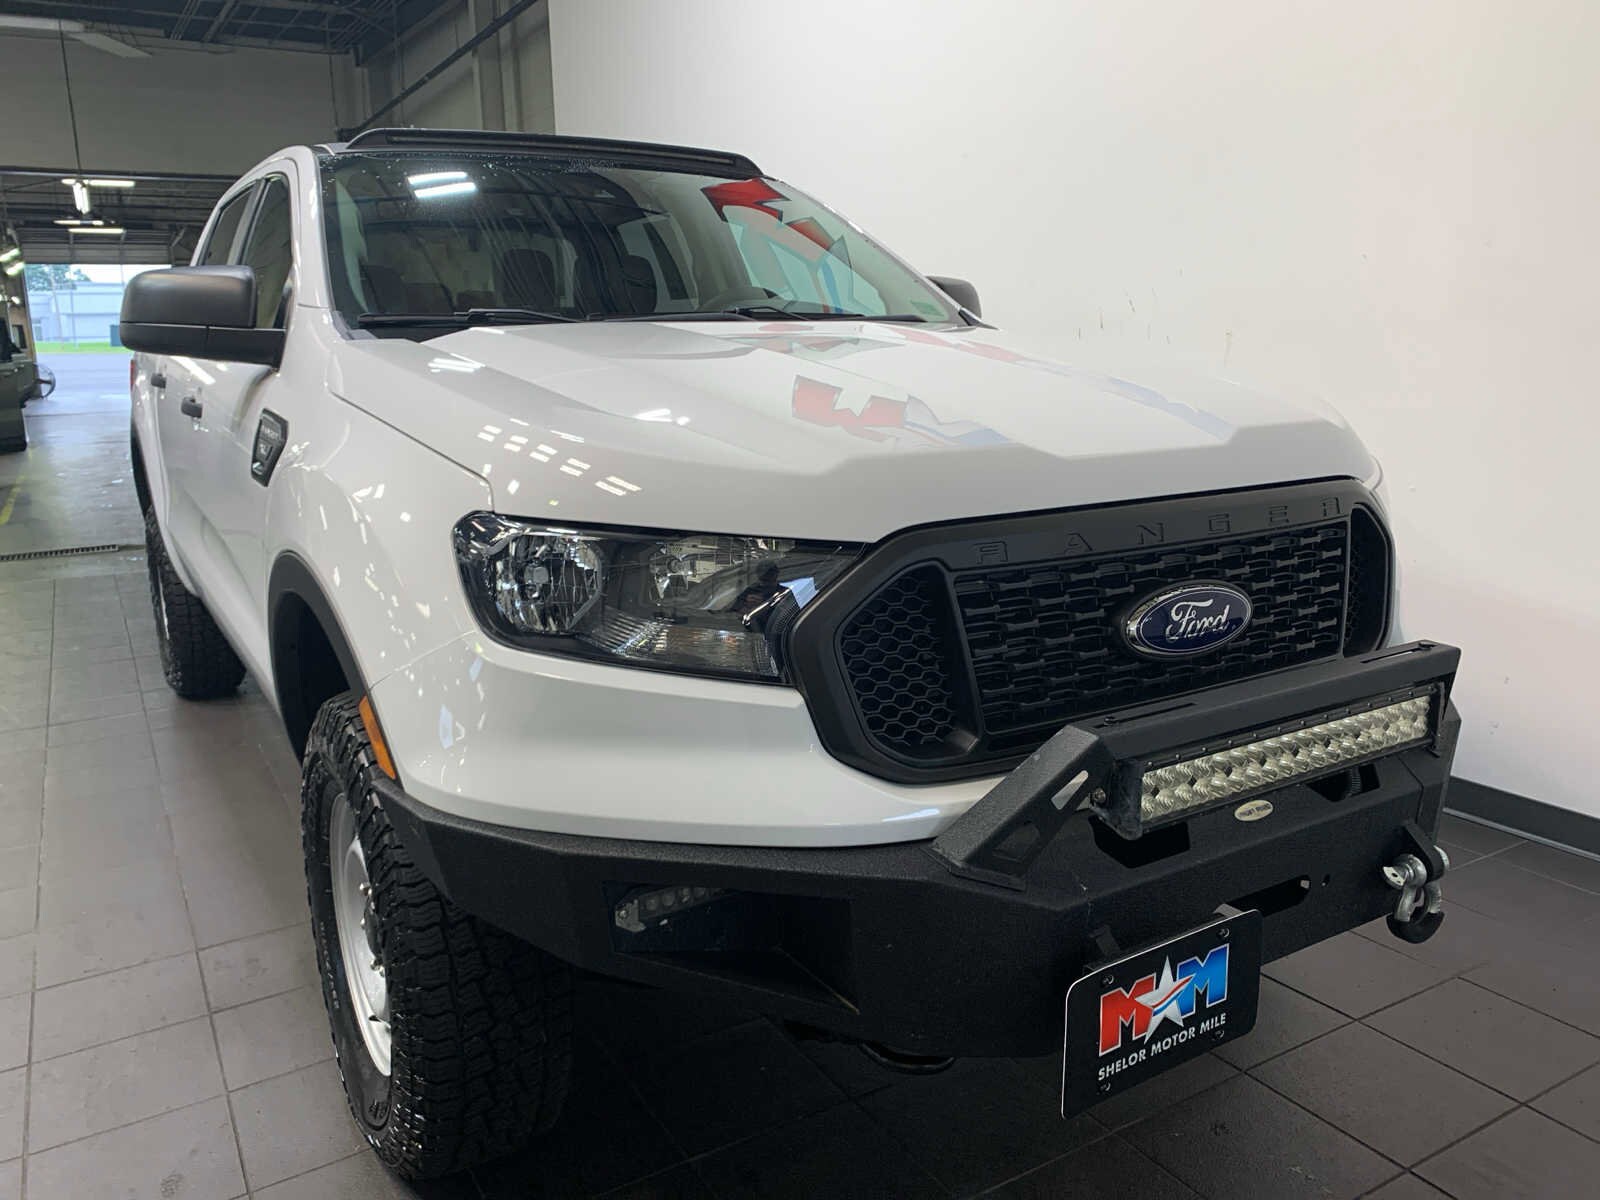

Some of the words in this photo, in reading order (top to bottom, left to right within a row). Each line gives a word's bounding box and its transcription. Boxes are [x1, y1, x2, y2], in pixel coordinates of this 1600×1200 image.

[1165, 598, 1230, 642] Ford
[1098, 1051, 1146, 1081] SHELOR
[1150, 1027, 1196, 1056] MOTOR
[1199, 1013, 1226, 1034] MILE
